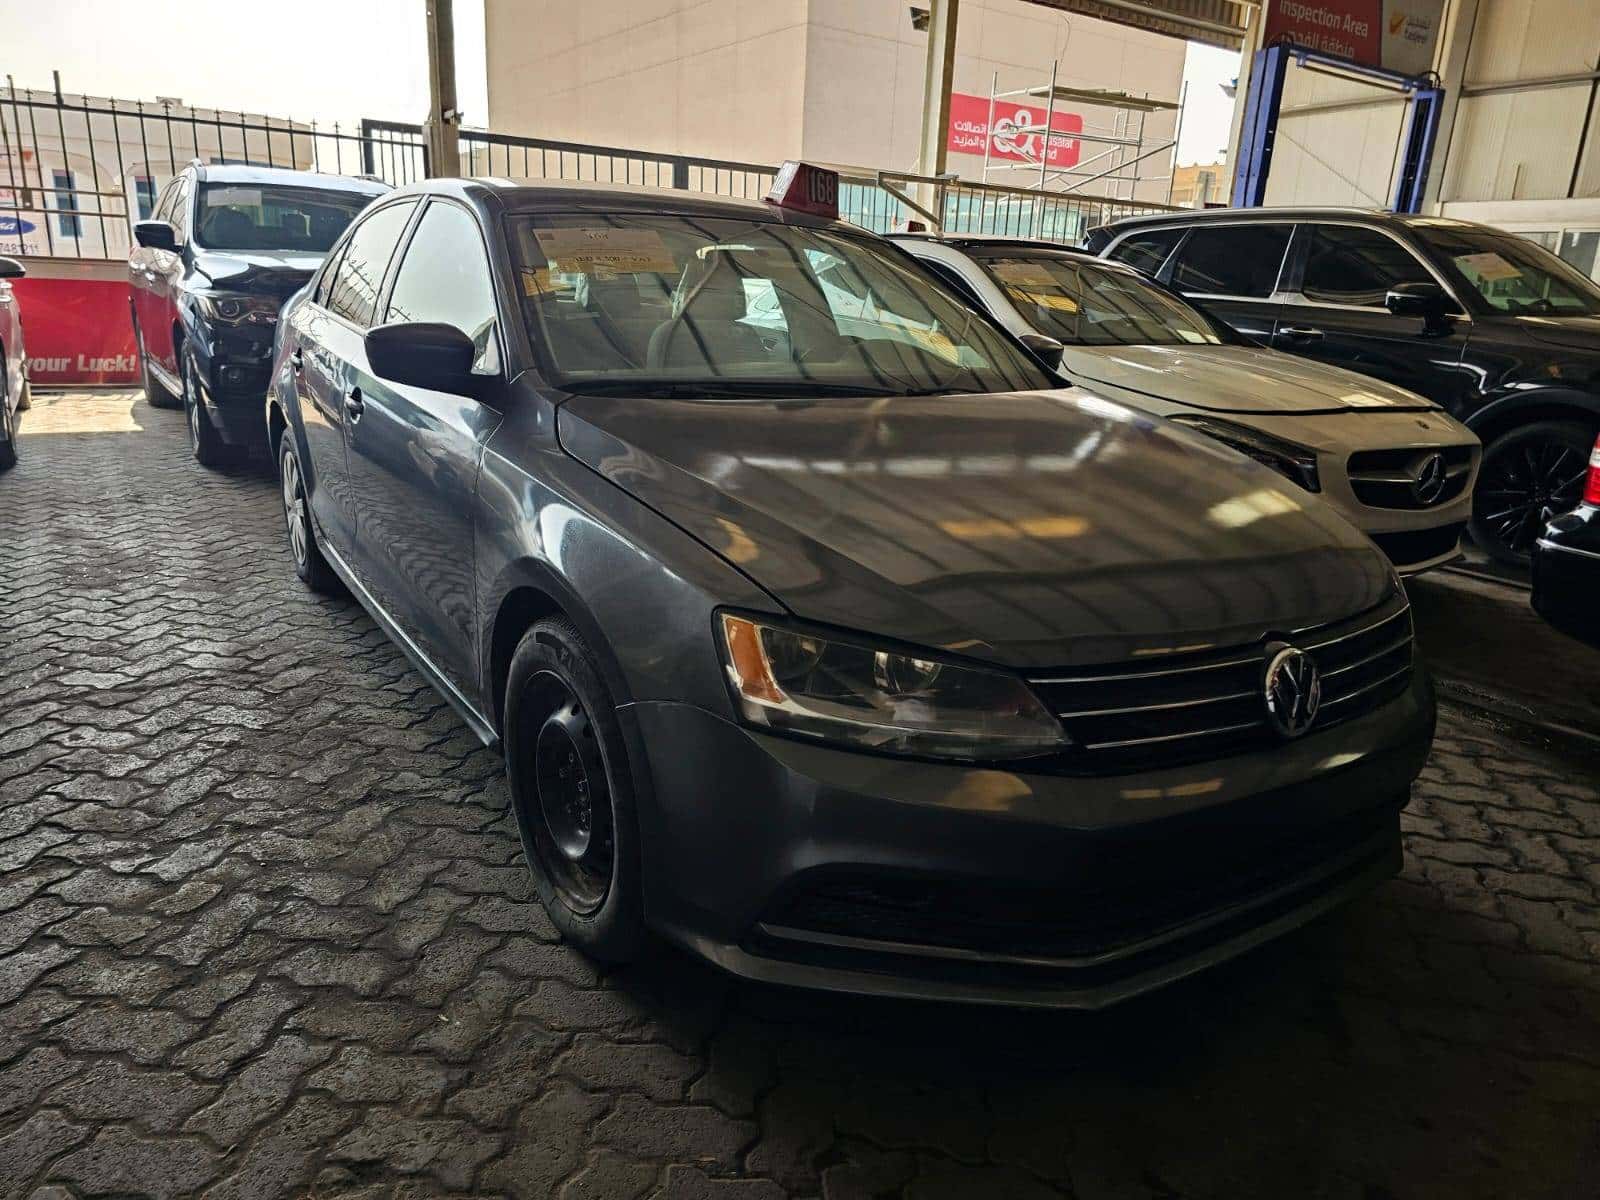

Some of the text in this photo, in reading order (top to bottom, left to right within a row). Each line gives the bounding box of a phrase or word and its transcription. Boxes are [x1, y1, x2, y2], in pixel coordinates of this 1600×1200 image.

[1279, 0, 1368, 39] Inspection Area
[809, 168, 834, 205] 168
[77, 354, 136, 372] Luck!
